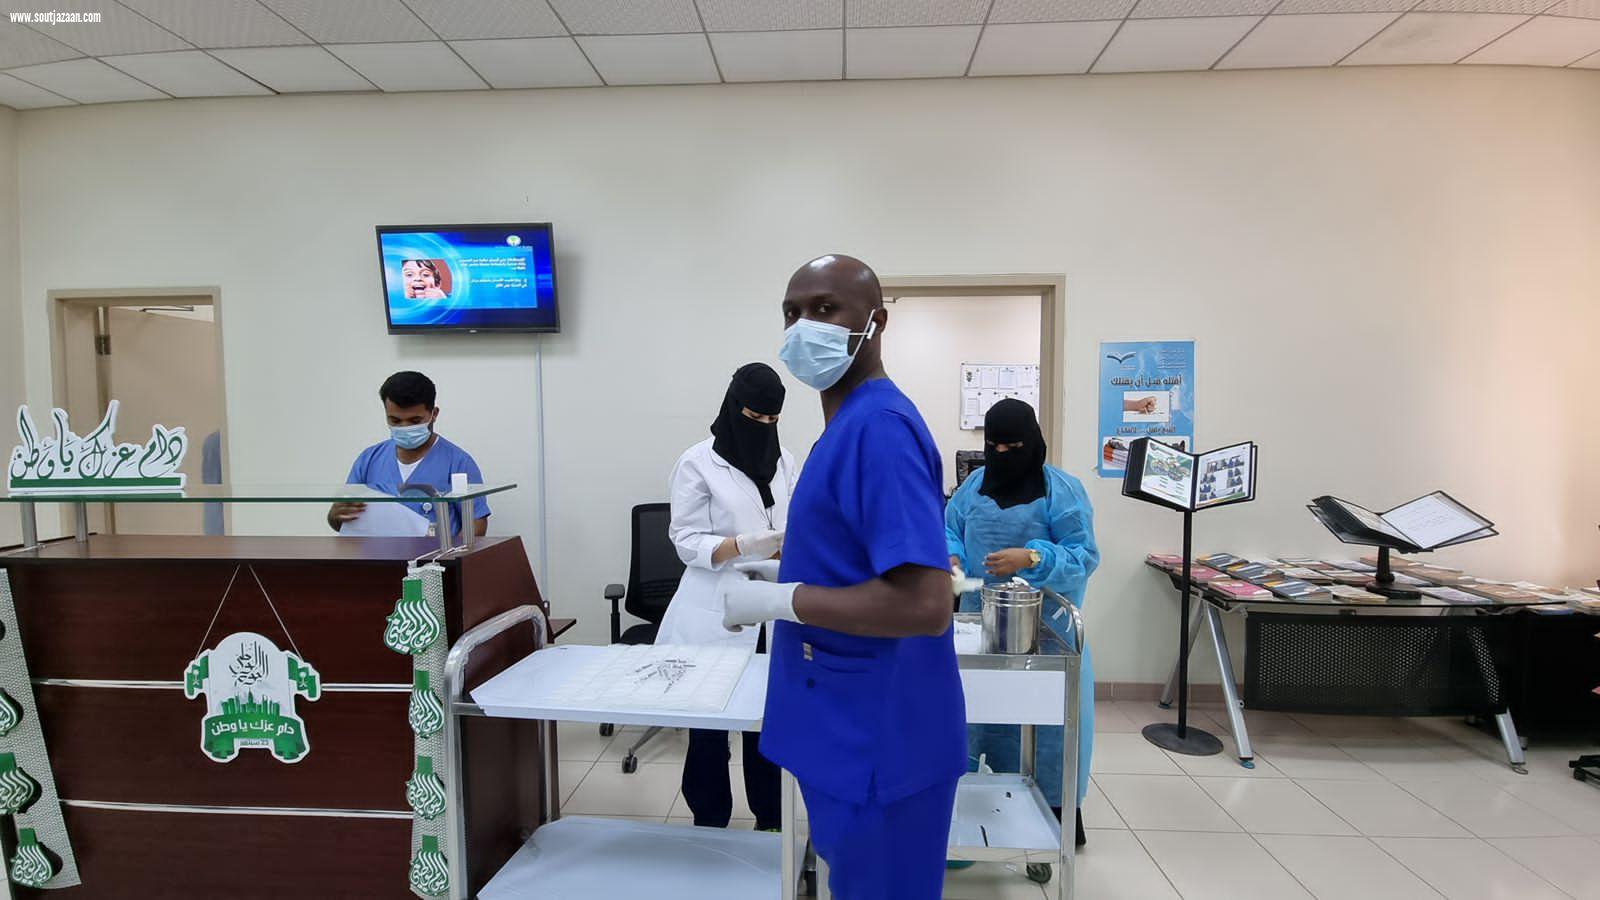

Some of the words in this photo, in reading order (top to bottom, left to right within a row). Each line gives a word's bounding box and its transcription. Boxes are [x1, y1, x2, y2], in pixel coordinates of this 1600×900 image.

[138, 427, 184, 478] دام
[211, 721, 238, 736] وطن
[238, 719, 248, 732] يا
[249, 720, 275, 732] عزك
[275, 722, 295, 736] دام
